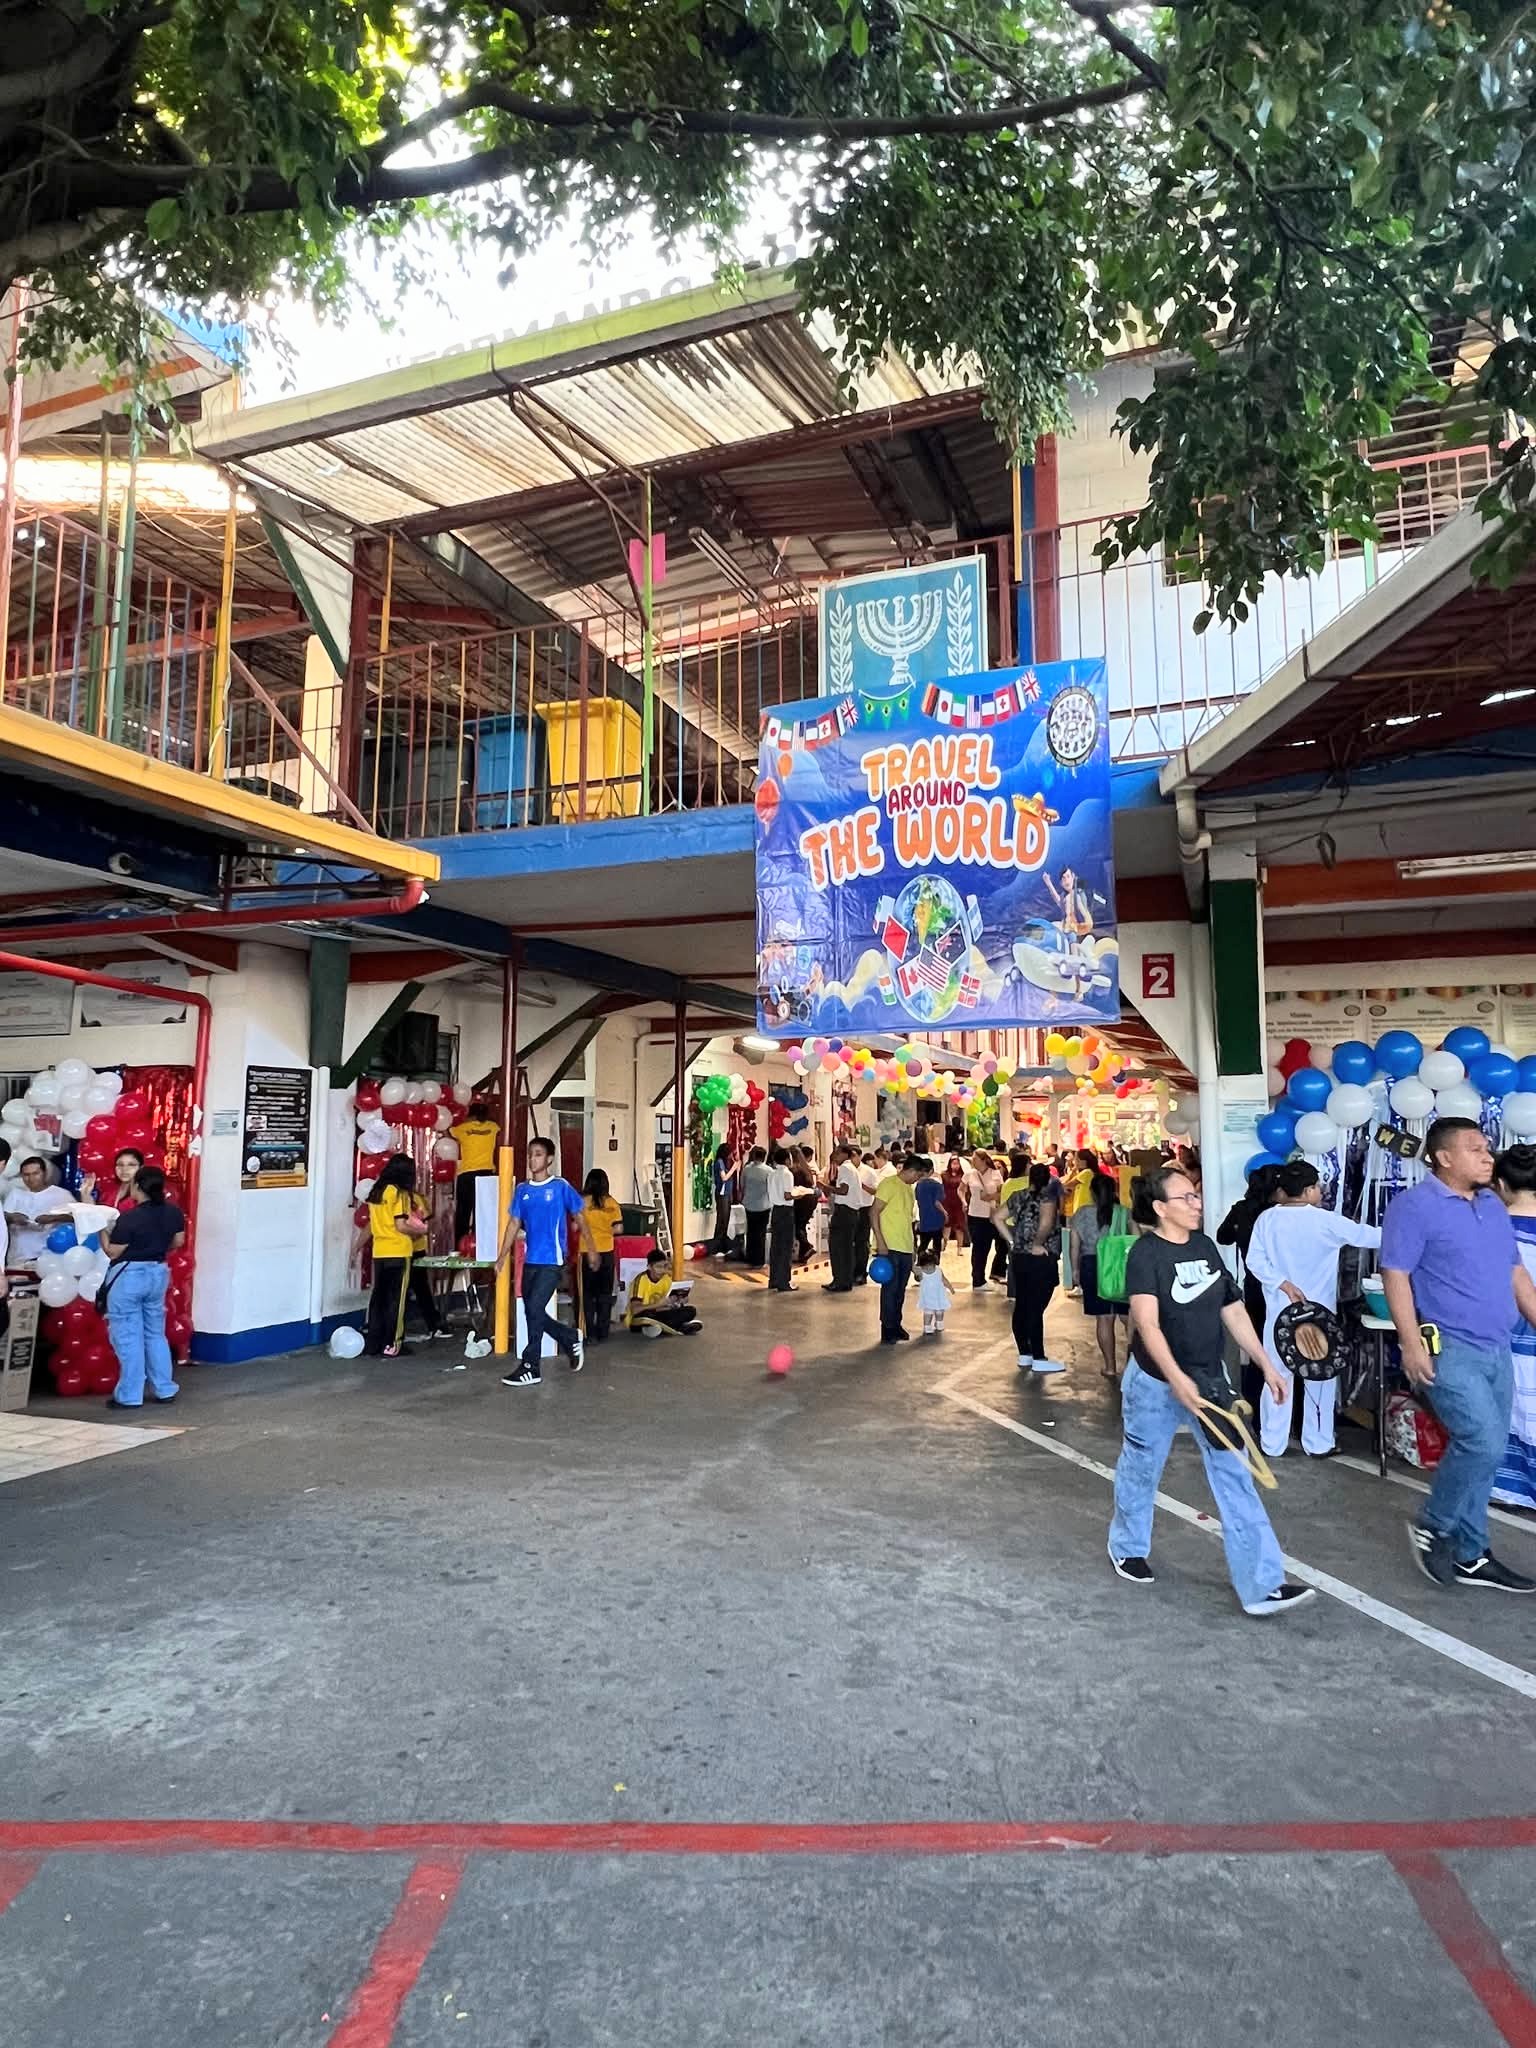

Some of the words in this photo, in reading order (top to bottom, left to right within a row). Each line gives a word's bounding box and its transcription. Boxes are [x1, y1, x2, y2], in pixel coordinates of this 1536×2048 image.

[862, 737, 1000, 799] TRAVEL
[888, 780, 967, 816] AROUND
[802, 809, 884, 888] THE
[896, 799, 1048, 868] WORLD
[1149, 966, 1169, 995] 2
[1174, 1259, 1211, 1286] NIKE
